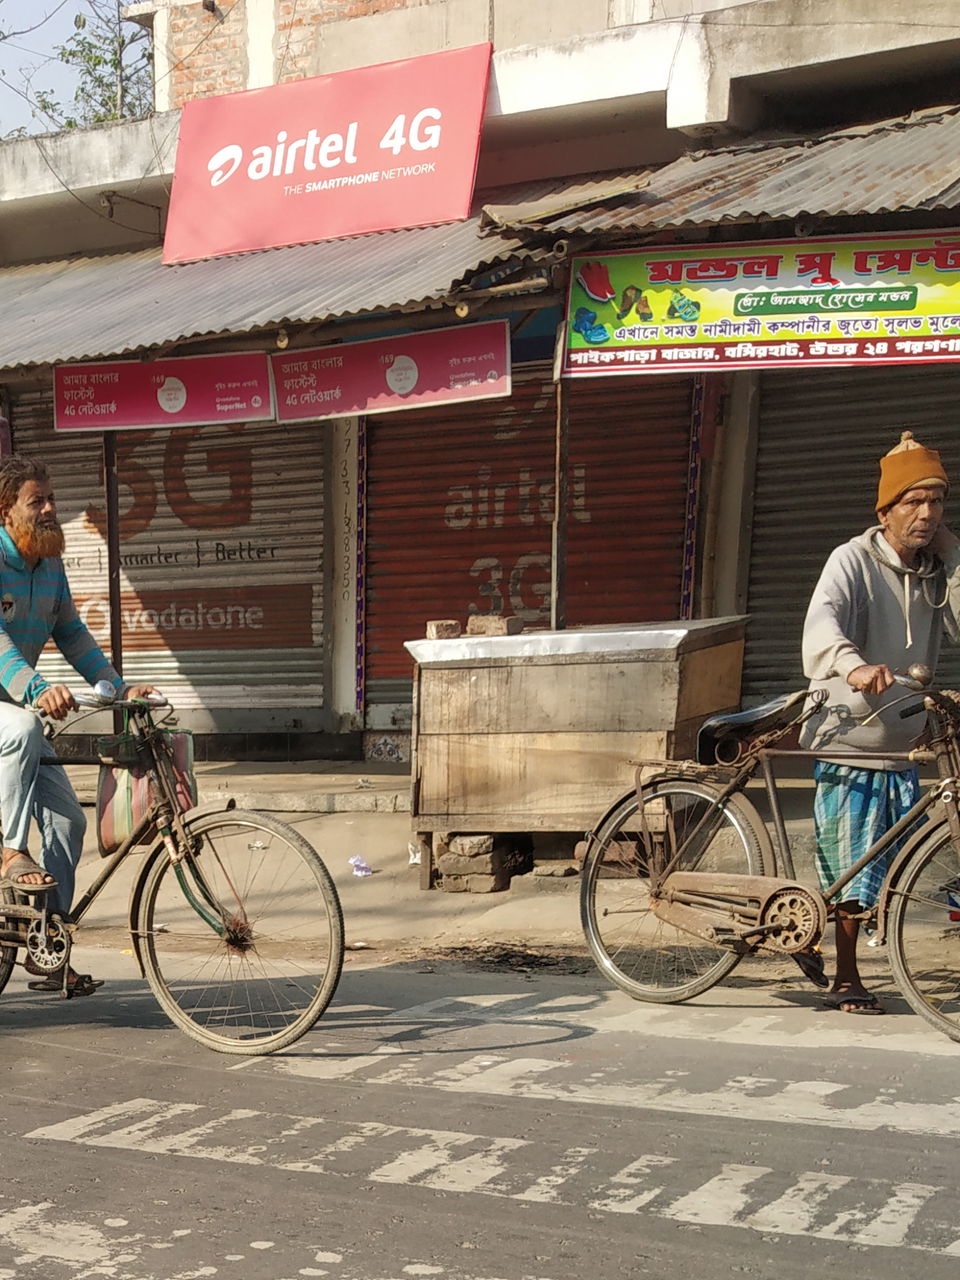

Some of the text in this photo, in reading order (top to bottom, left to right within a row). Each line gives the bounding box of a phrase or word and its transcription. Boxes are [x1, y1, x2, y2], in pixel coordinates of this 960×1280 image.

[247, 107, 442, 180] airtel 4G
[284, 162, 437, 196] THE SMARTPHONE NETWORK
[615, 326, 659, 341] এখানে
[664, 325, 698, 338] সমস্ত
[281, 356, 344, 373] আমার বাংলার
[569, 347, 657, 364] পাইকপাড়া
[63, 373, 119, 385] আমার বাংলার
[286, 385, 342, 406] 4G নেটওয়ার্ক
[64, 400, 117, 416] 4G নেটওয়ার্ক
[444, 464, 592, 530] airtel
[118, 541, 280, 567] marter Better
[468, 551, 553, 622] 3G
[121, 601, 264, 632] vodafone
